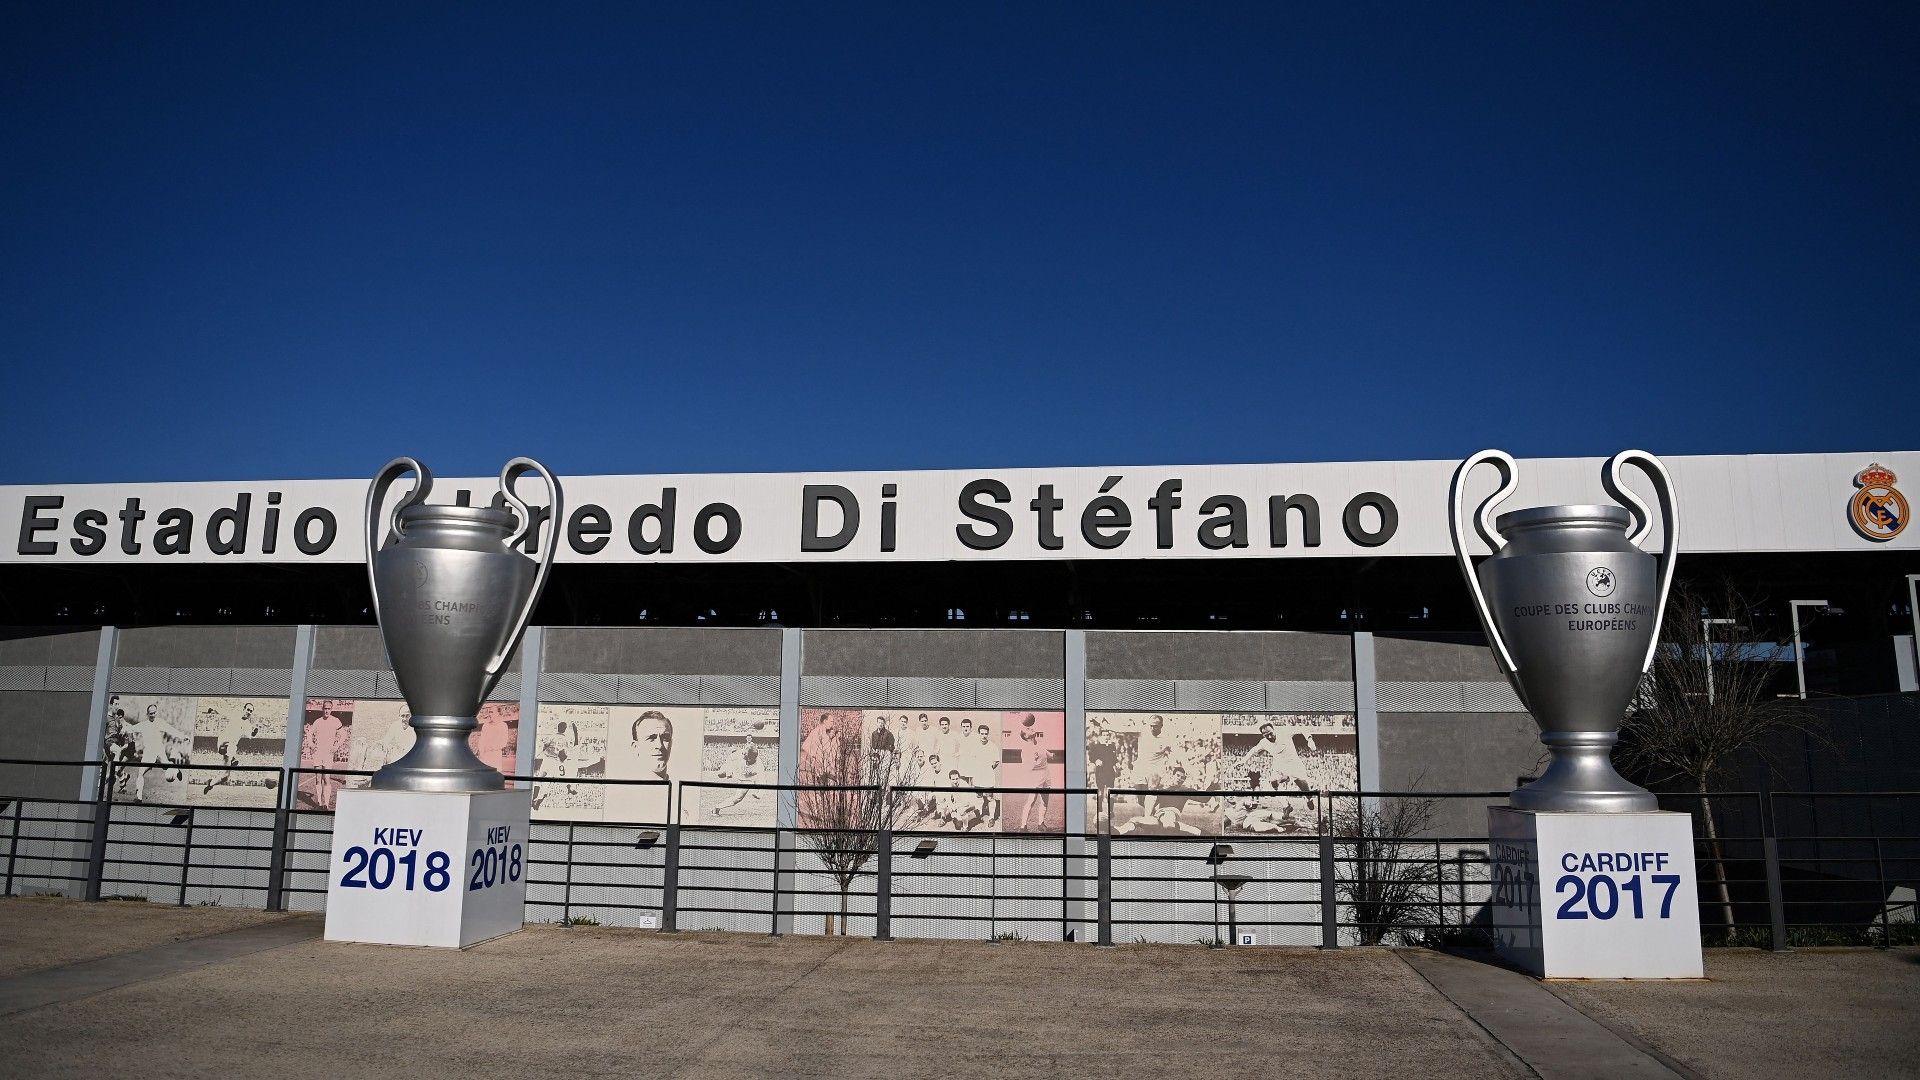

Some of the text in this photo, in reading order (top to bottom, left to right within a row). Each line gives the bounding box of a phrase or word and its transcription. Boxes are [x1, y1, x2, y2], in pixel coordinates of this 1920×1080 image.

[17, 491, 338, 556] Estadio
[800, 484, 898, 553] Di
[956, 475, 1399, 551] Stéfano
[1514, 604, 1552, 618] COUPE
[1555, 603, 1579, 615] DES
[1584, 603, 1621, 615] CLUBS
[1568, 618, 1637, 631] EUROPÉENS
[558, 764, 566, 777] 9
[373, 827, 424, 847] KIEV
[486, 825, 512, 846] KIEV
[340, 846, 451, 893] 2018
[469, 843, 522, 892] 2018
[1561, 852, 1670, 873] CARDIFF
[1494, 862, 1535, 915] 2017
[1555, 874, 1681, 920] 2017
